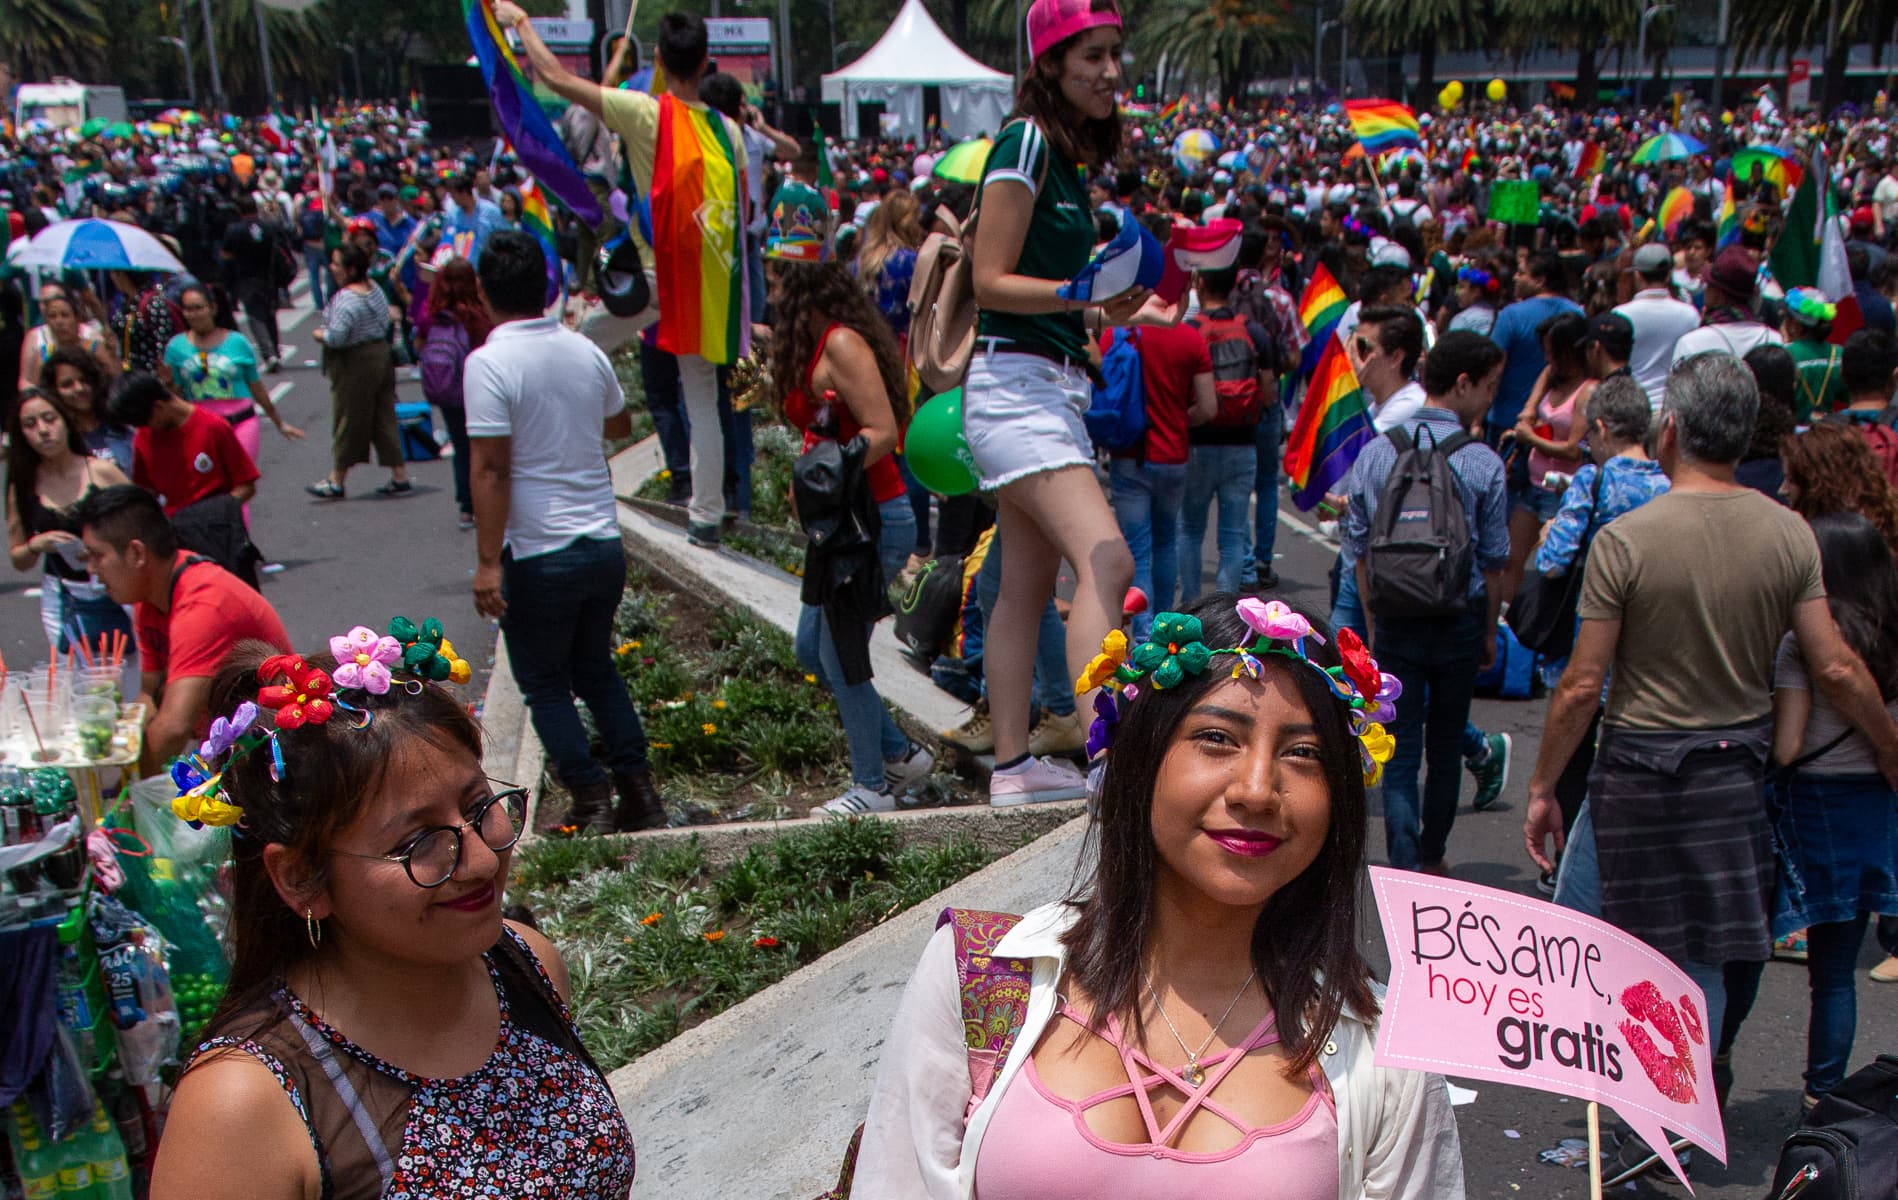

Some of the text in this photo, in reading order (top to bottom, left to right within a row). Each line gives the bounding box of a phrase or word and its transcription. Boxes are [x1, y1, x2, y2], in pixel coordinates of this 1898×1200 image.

[112, 972, 132, 987] 25
[1411, 900, 1612, 1005] Bésame,
[1428, 963, 1544, 1018] hoy es
[1497, 1016, 1623, 1082] gratis
